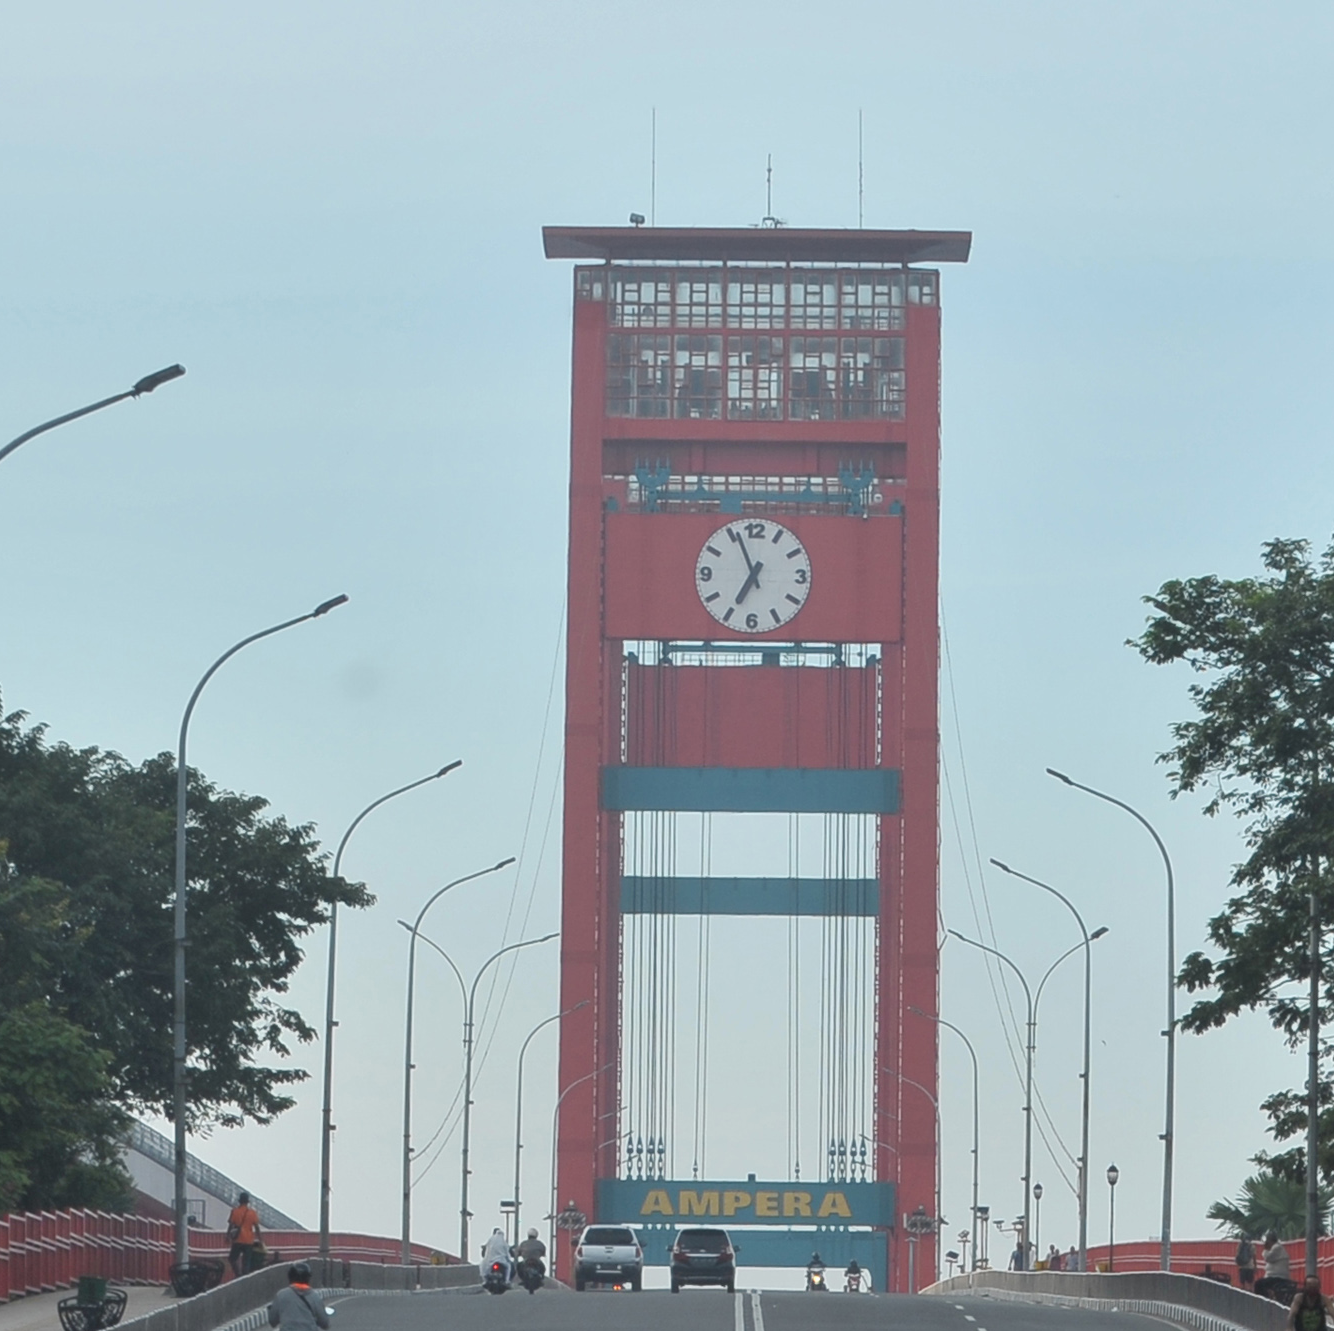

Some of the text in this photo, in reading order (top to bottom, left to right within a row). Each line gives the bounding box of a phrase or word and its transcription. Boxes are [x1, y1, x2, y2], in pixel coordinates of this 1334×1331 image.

[744, 523, 765, 539] 12
[700, 567, 712, 581] 9
[795, 569, 807, 584] 3
[746, 614, 758, 628] 6
[640, 1189, 852, 1217] AMPERA
